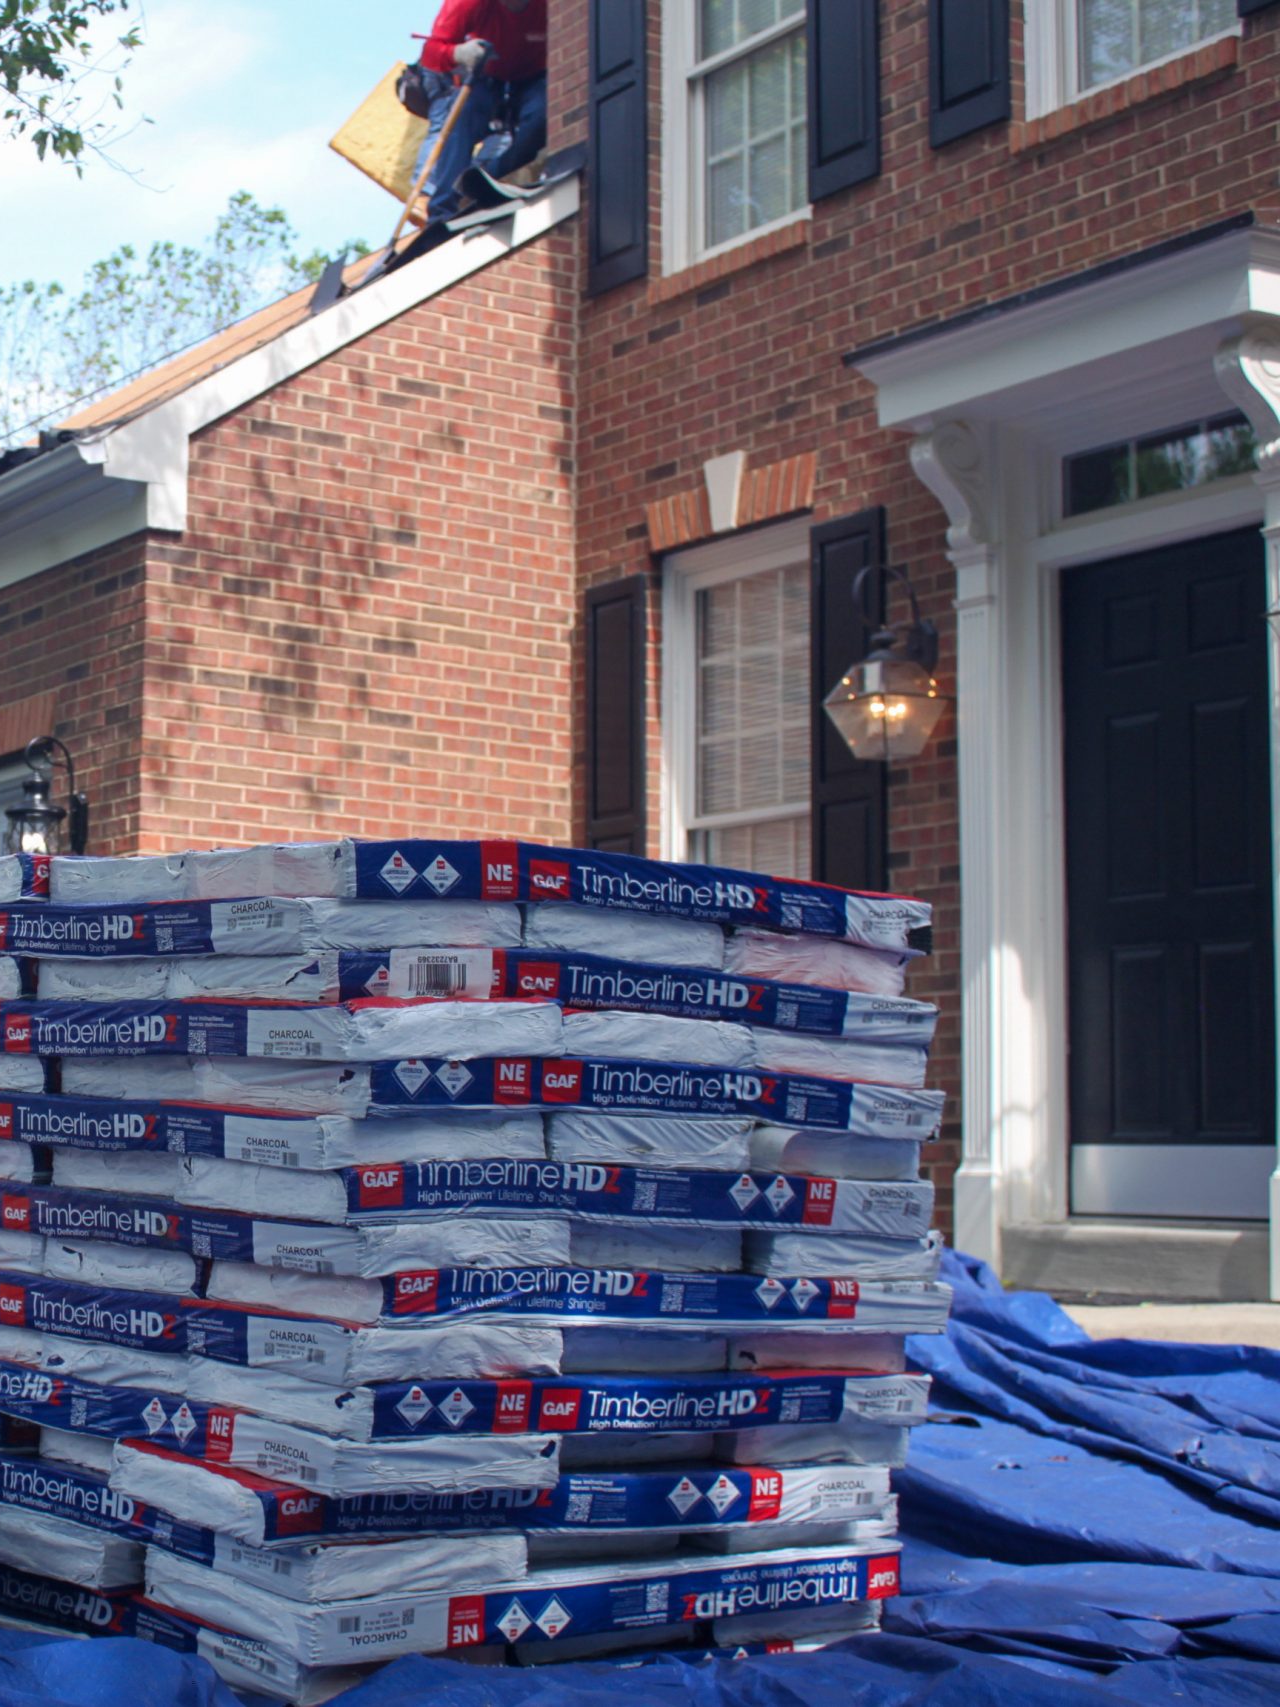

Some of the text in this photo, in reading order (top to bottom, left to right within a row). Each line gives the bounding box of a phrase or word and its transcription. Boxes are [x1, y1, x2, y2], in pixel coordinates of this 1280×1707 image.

[487, 864, 512, 882] NE
[533, 875, 566, 889] GAF
[231, 900, 275, 914] CHARCOAL
[583, 894, 730, 919] High Definition Shingles
[29, 941, 59, 950] Definition
[521, 977, 555, 991] GAF
[571, 998, 594, 1007] High
[596, 999, 640, 1010] Definition
[7, 1027, 29, 1040] GAF
[269, 1030, 313, 1039] CHARCOAL
[39, 1045, 53, 1054] High
[55, 1045, 86, 1054] Definition
[500, 1064, 525, 1081] NE
[545, 1074, 578, 1088] GAF
[593, 1094, 614, 1104] High
[616, 1094, 663, 1107] Definition
[21, 1132, 35, 1142] High
[37, 1134, 68, 1144] Definition
[98, 1139, 126, 1149] Shingles
[246, 1137, 290, 1149] CHARCOAL
[363, 1172, 399, 1187] GAF
[418, 1190, 442, 1202] High
[444, 1191, 492, 1201] Definition
[498, 1190, 533, 1202] Lifetime
[810, 1182, 831, 1200] NE
[5, 1207, 27, 1221] GAF
[39, 1227, 55, 1236] High
[57, 1227, 89, 1237] Definition
[277, 1244, 325, 1258] CHARCOAL
[399, 1277, 434, 1294] GAF
[834, 1281, 856, 1296] NE
[0, 1298, 23, 1313] GAF
[568, 1298, 605, 1311] Shingles
[35, 1321, 50, 1331] High
[52, 1323, 81, 1335] Definition
[270, 1330, 318, 1344] CHARCOAL
[500, 1395, 525, 1411] NE
[543, 1403, 576, 1416] GAF
[211, 1415, 230, 1437] NE
[588, 1420, 610, 1429] High
[613, 1419, 656, 1429] Definition
[696, 1418, 730, 1427] Shingles
[265, 1441, 309, 1461] CHARCOAL
[756, 1477, 779, 1496] NE
[817, 1480, 866, 1492] CHARCOAL
[20, 1496, 53, 1510] Definition
[281, 1500, 320, 1516] GAF
[370, 1516, 417, 1526] Definition
[794, 1563, 836, 1576] Definition
[870, 1572, 896, 1588] GAF
[349, 1630, 407, 1646] CHARCOAL
[452, 1624, 478, 1643] NE
